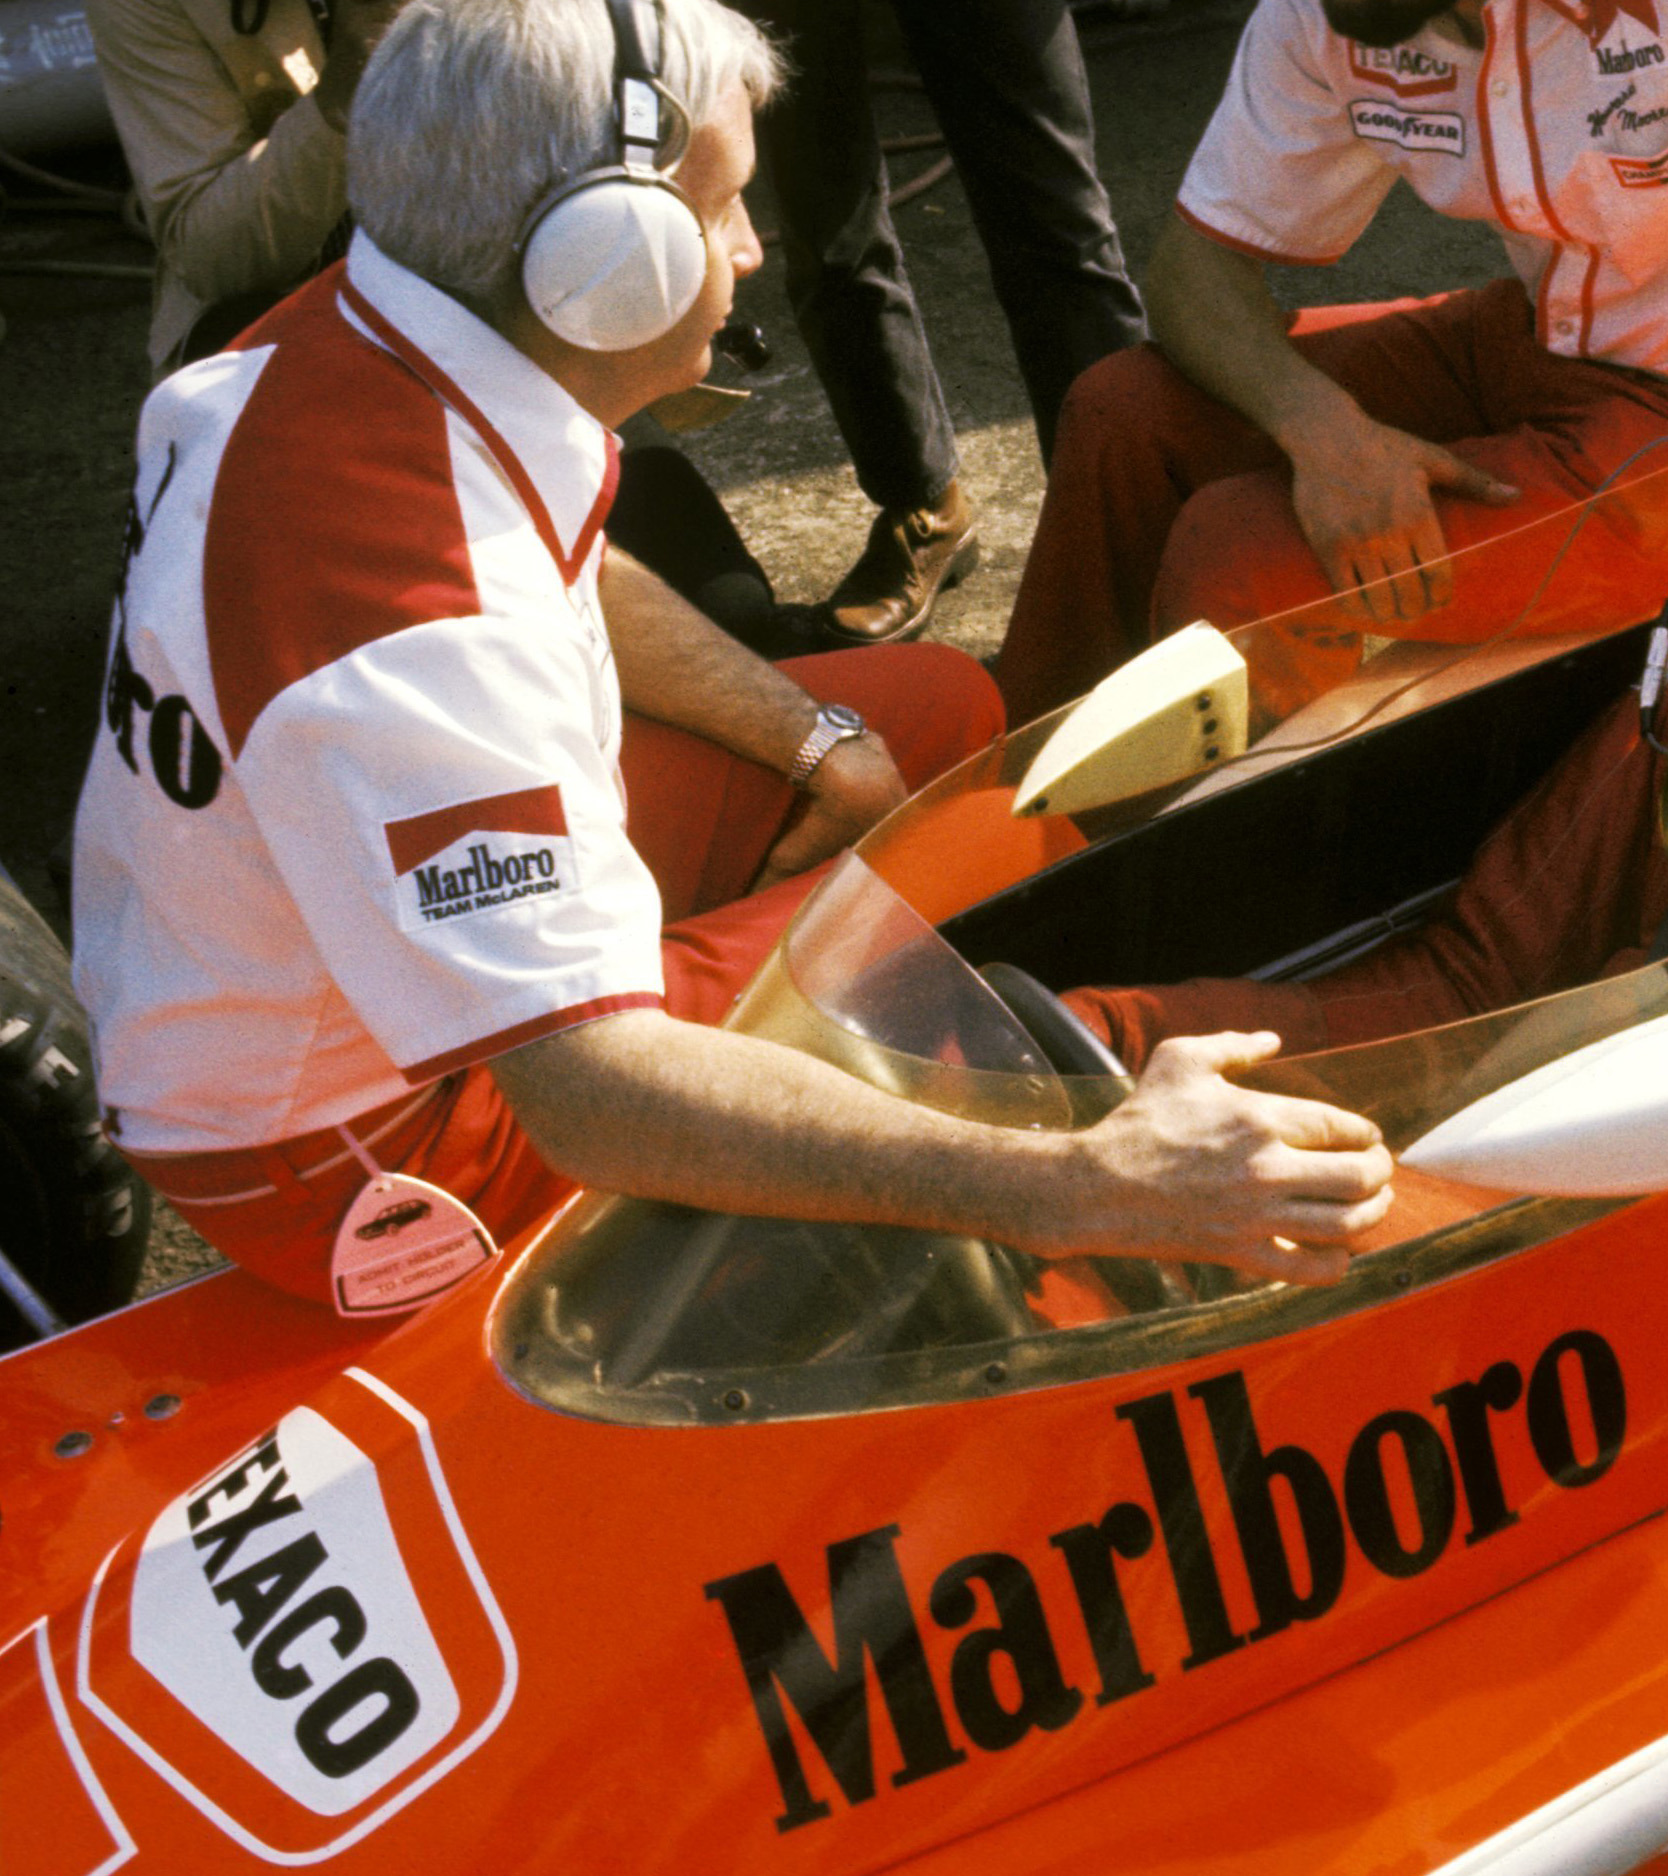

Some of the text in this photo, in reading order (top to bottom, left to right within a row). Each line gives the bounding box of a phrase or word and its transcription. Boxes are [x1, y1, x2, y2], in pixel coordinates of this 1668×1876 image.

[413, 843, 555, 908] Marlboro
[420, 879, 561, 923] TEAM McLAREN
[704, 1329, 1627, 1834] Marlboro
